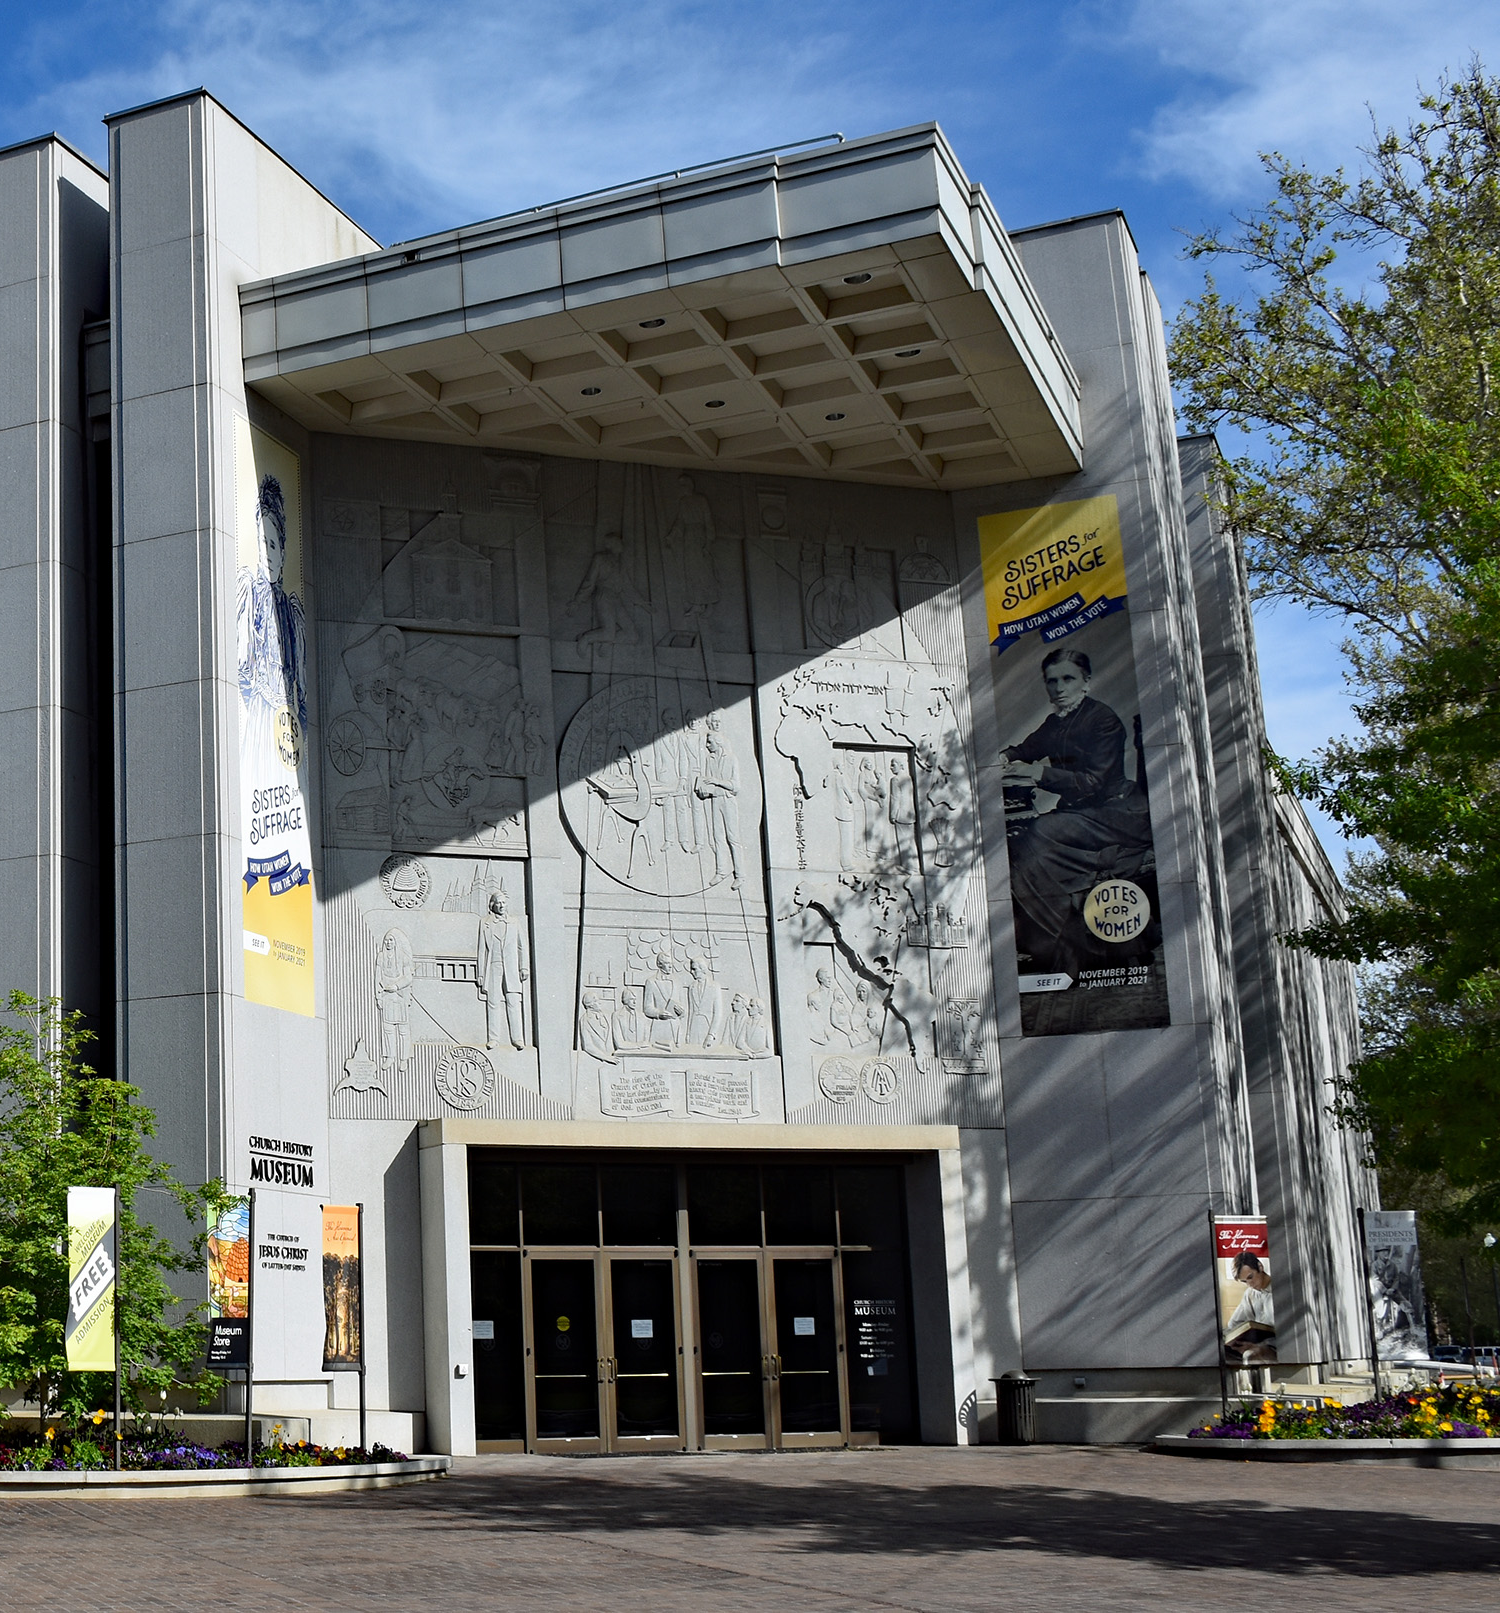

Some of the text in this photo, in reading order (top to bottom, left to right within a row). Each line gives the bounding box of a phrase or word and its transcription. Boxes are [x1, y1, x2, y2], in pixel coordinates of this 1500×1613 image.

[1005, 528, 1099, 583] SISTERS for
[1002, 546, 1106, 610] SUFFRAGE
[1004, 597, 1080, 635] HOW UTAH WOMEN
[1046, 601, 1107, 639] WON THE VOTE
[278, 712, 298, 738] VOTES
[283, 732, 294, 743] FOR
[278, 737, 299, 767] WOMEN
[252, 785, 290, 814] SISTERS
[250, 807, 302, 845] SUFFRAGE
[271, 867, 302, 893] WON THE VOTE
[1094, 886, 1138, 906] VOTES
[1094, 913, 1141, 937] WOMEN
[1104, 906, 1129, 918] FOR
[1037, 978, 1061, 987] SEE IT
[1079, 966, 1148, 980] NOVEMBER 2019
[1088, 978, 1126, 990] JANUARY
[1127, 976, 1148, 985] 2021
[249, 1136, 313, 1157] CHURCH HISTORY
[250, 1157, 313, 1188] MUSEUM
[75, 1224, 97, 1253] WELCOME
[81, 1220, 106, 1258] MUSEUM
[1369, 1230, 1413, 1238] PRESIDENTS
[259, 1245, 308, 1261] JESUS CHRIST
[75, 1256, 108, 1307] FREE
[75, 1296, 110, 1344] ADMISSION
[854, 1307, 896, 1315] MUSEUM
[213, 1336, 230, 1346] Store
[215, 1325, 242, 1335] Museum
